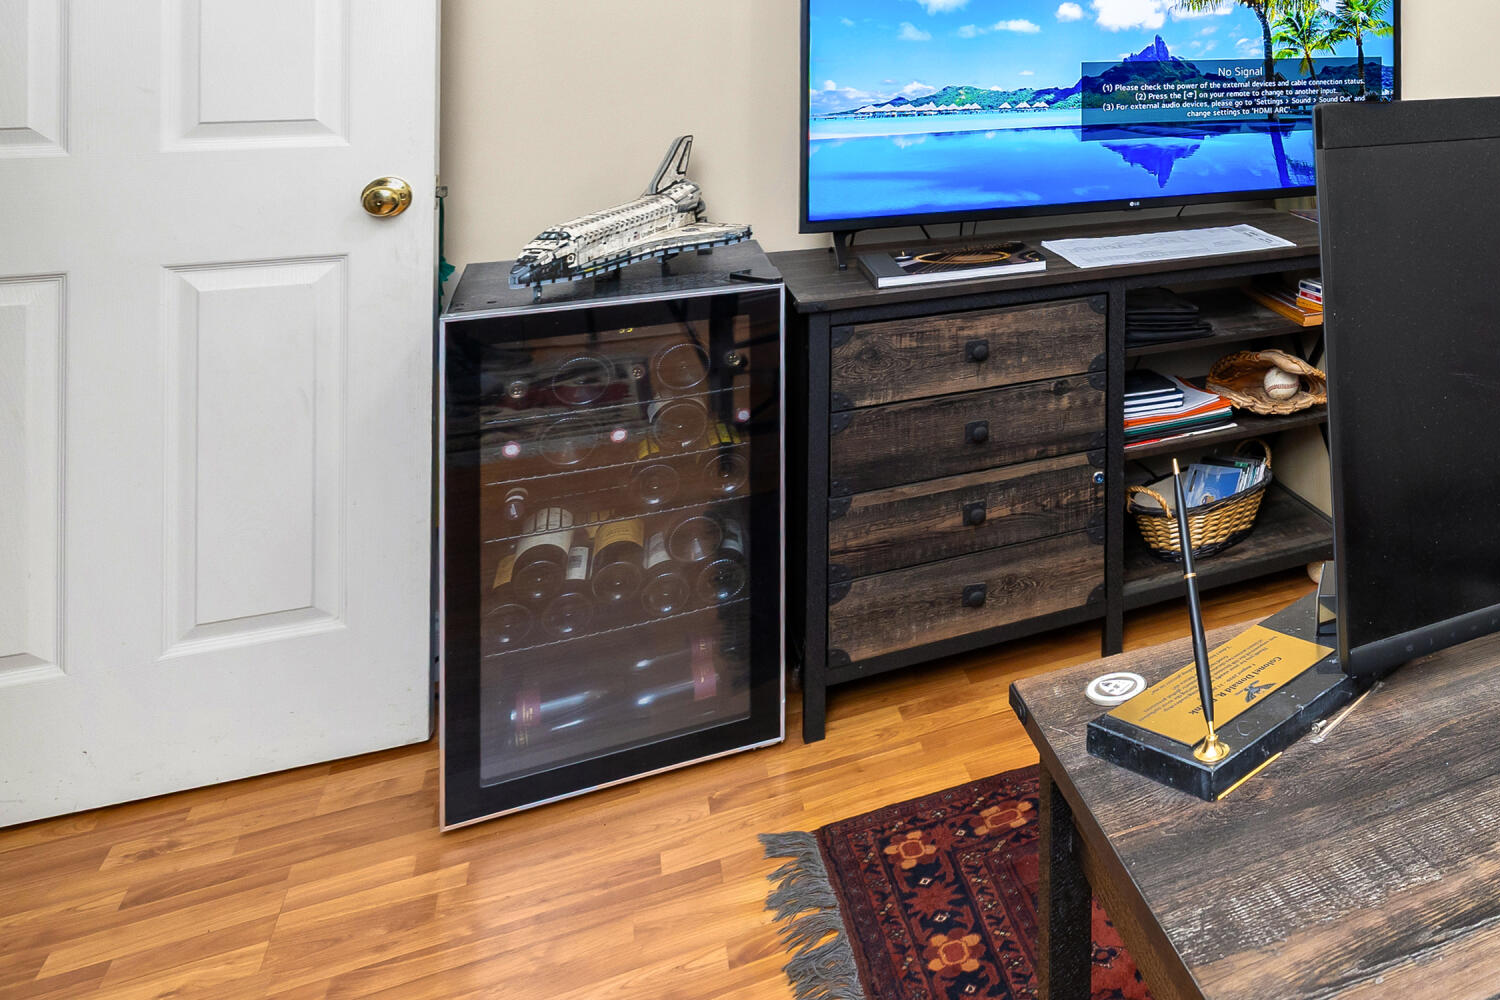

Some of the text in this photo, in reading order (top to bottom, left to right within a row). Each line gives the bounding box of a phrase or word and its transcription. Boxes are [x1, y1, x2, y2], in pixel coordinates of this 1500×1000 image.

[1218, 67, 1263, 78] No Signal
[1102, 83, 1113, 93] (1)
[1140, 83, 1161, 91] check
[1176, 83, 1198, 91] power
[1209, 81, 1221, 89] the
[1222, 80, 1251, 88] external
[1308, 78, 1343, 86] connection
[1135, 92, 1147, 101] (2)
[1148, 92, 1168, 100] Press
[1169, 91, 1182, 99] the
[1209, 91, 1225, 99] your
[1226, 89, 1251, 97] remote
[1261, 89, 1284, 98] change
[1102, 102, 1115, 112] (3)
[1130, 102, 1160, 110] external
[1161, 101, 1180, 109] audio
[1211, 99, 1233, 108] please
[1234, 100, 1243, 108] go
[1318, 95, 1338, 103] Sound
[1187, 109, 1211, 118] change
[1213, 107, 1241, 117] settings
[1250, 655, 1283, 675] Colonel
[1222, 672, 1256, 693] Donald
